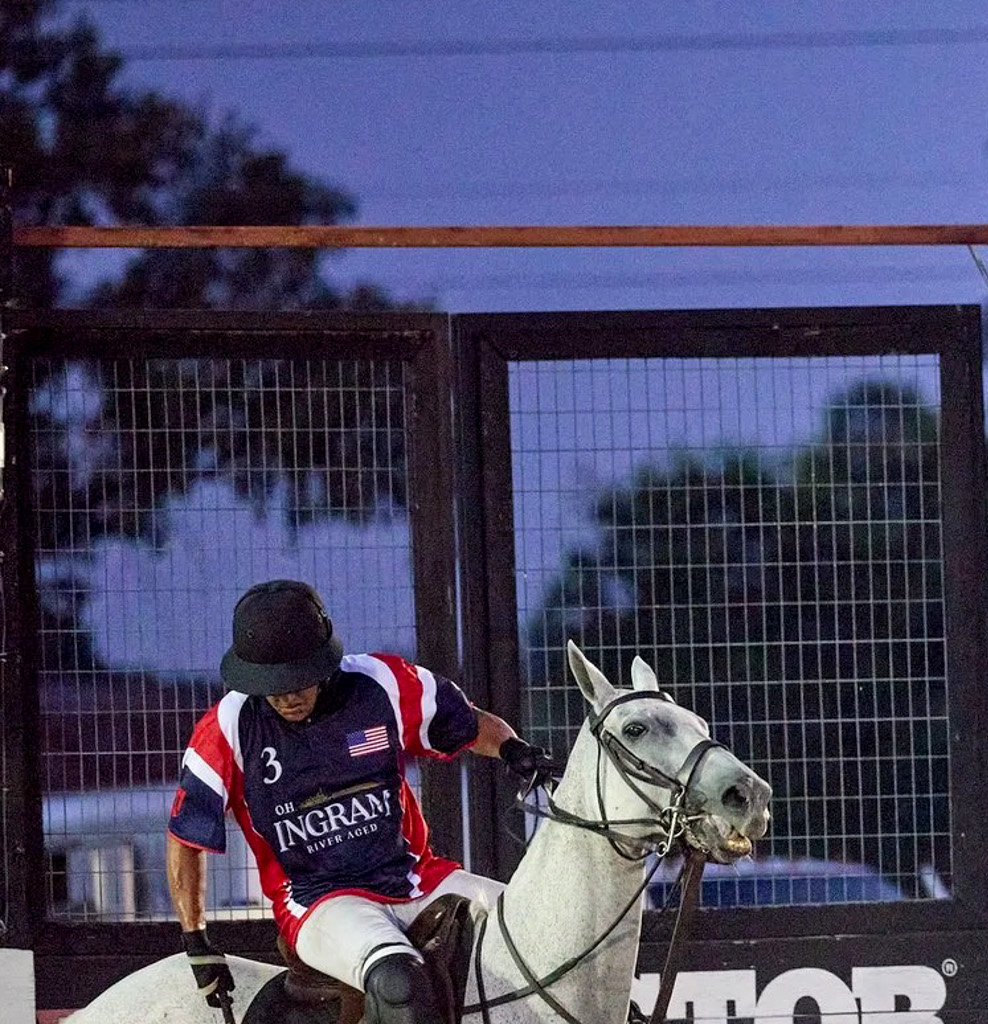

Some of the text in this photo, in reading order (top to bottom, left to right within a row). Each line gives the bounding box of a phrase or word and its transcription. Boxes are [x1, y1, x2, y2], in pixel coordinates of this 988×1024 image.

[261, 746, 283, 785] 3
[273, 789, 391, 853] INGRAM
[275, 801, 295, 816] OH
[306, 823, 378, 854] RIVER AGED
